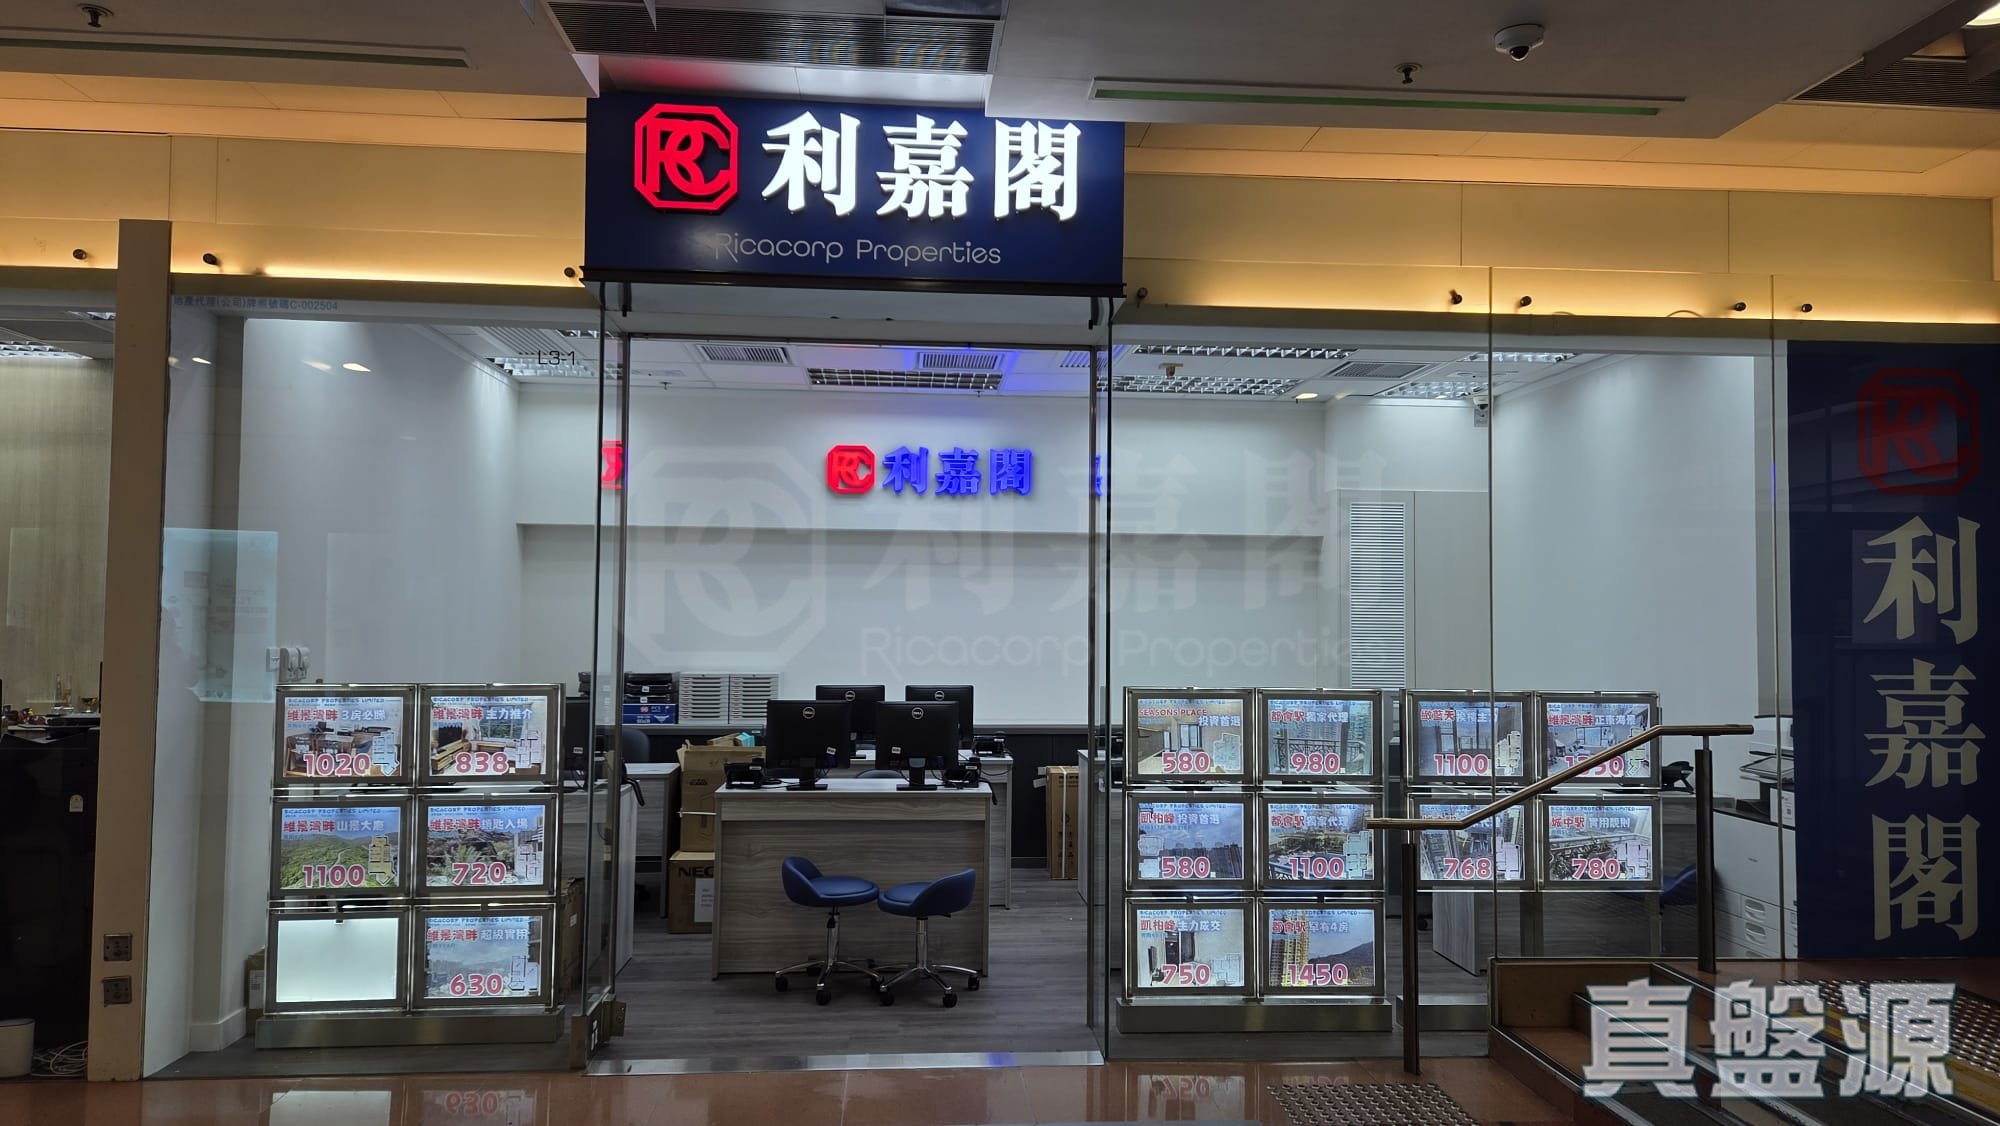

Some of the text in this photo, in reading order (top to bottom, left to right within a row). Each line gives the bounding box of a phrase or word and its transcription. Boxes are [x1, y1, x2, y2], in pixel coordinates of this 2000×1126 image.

[762, 110, 1082, 221] 利嘉閣
[713, 233, 1002, 266] Ricacorp Properties
[538, 350, 575, 366] L3-1
[881, 446, 1034, 495] 利嘉閣
[1139, 708, 1208, 717] SEASONS PLACE
[1862, 516, 1986, 941] 利嘉閣
[303, 753, 372, 776] 1020
[455, 752, 509, 774] 838
[1162, 751, 1211, 773] 580
[1291, 752, 1341, 774] 980
[1433, 753, 1489, 776] 1100
[303, 864, 365, 888] 1100
[452, 862, 506, 886] 720
[1161, 856, 1211, 878] 580
[1289, 857, 1344, 878] 1100
[1443, 857, 1492, 879] 768
[1572, 858, 1621, 880] 780
[449, 973, 503, 996] 630
[1161, 964, 1211, 985] 750
[1287, 963, 1348, 985] 1450
